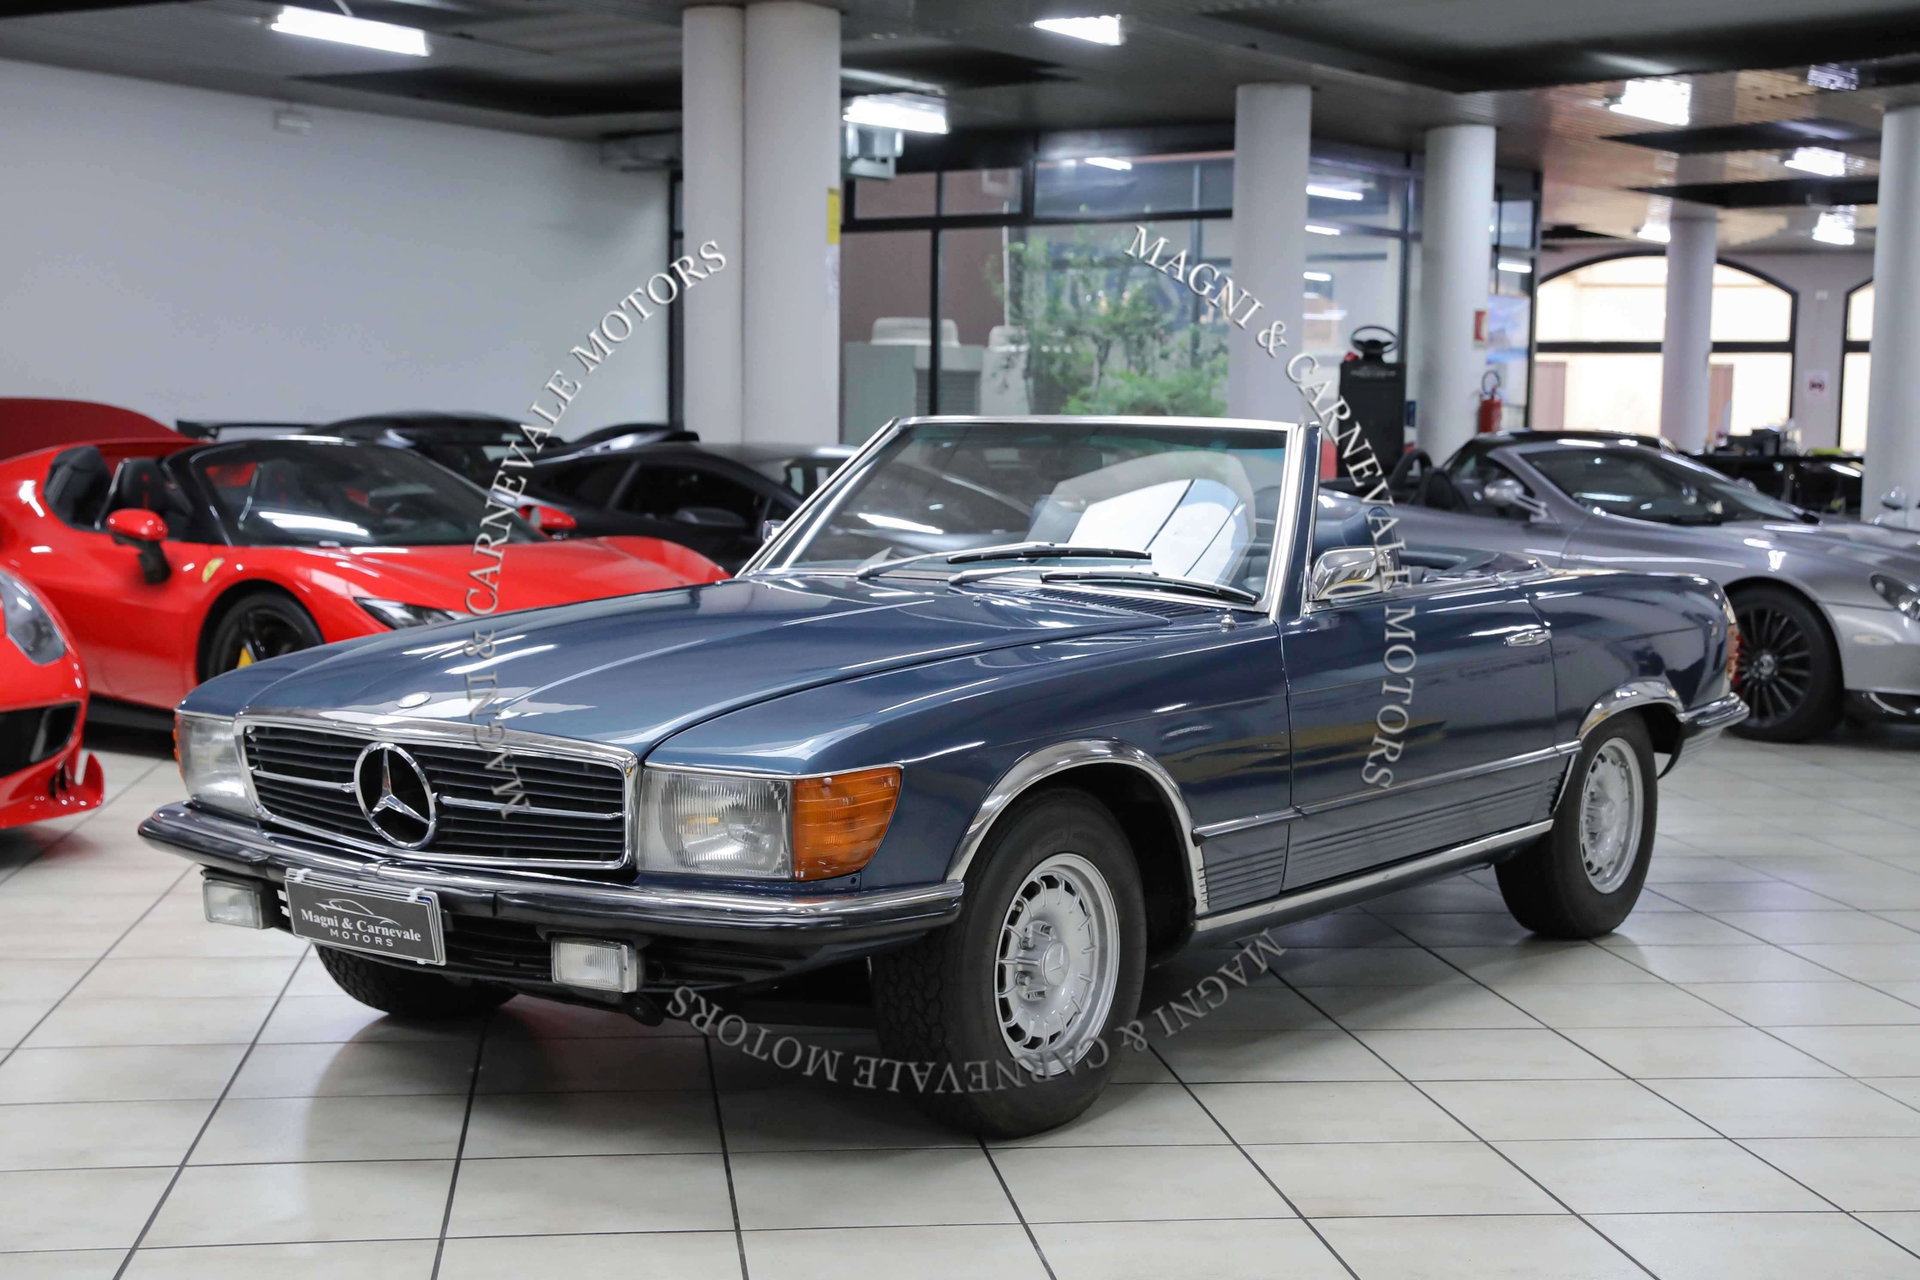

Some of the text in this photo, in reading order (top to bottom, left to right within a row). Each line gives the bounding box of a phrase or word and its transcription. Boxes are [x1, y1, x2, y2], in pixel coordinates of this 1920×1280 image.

[301, 909, 422, 942] Magni & Carnevale
[330, 928, 394, 947] MOTORS
